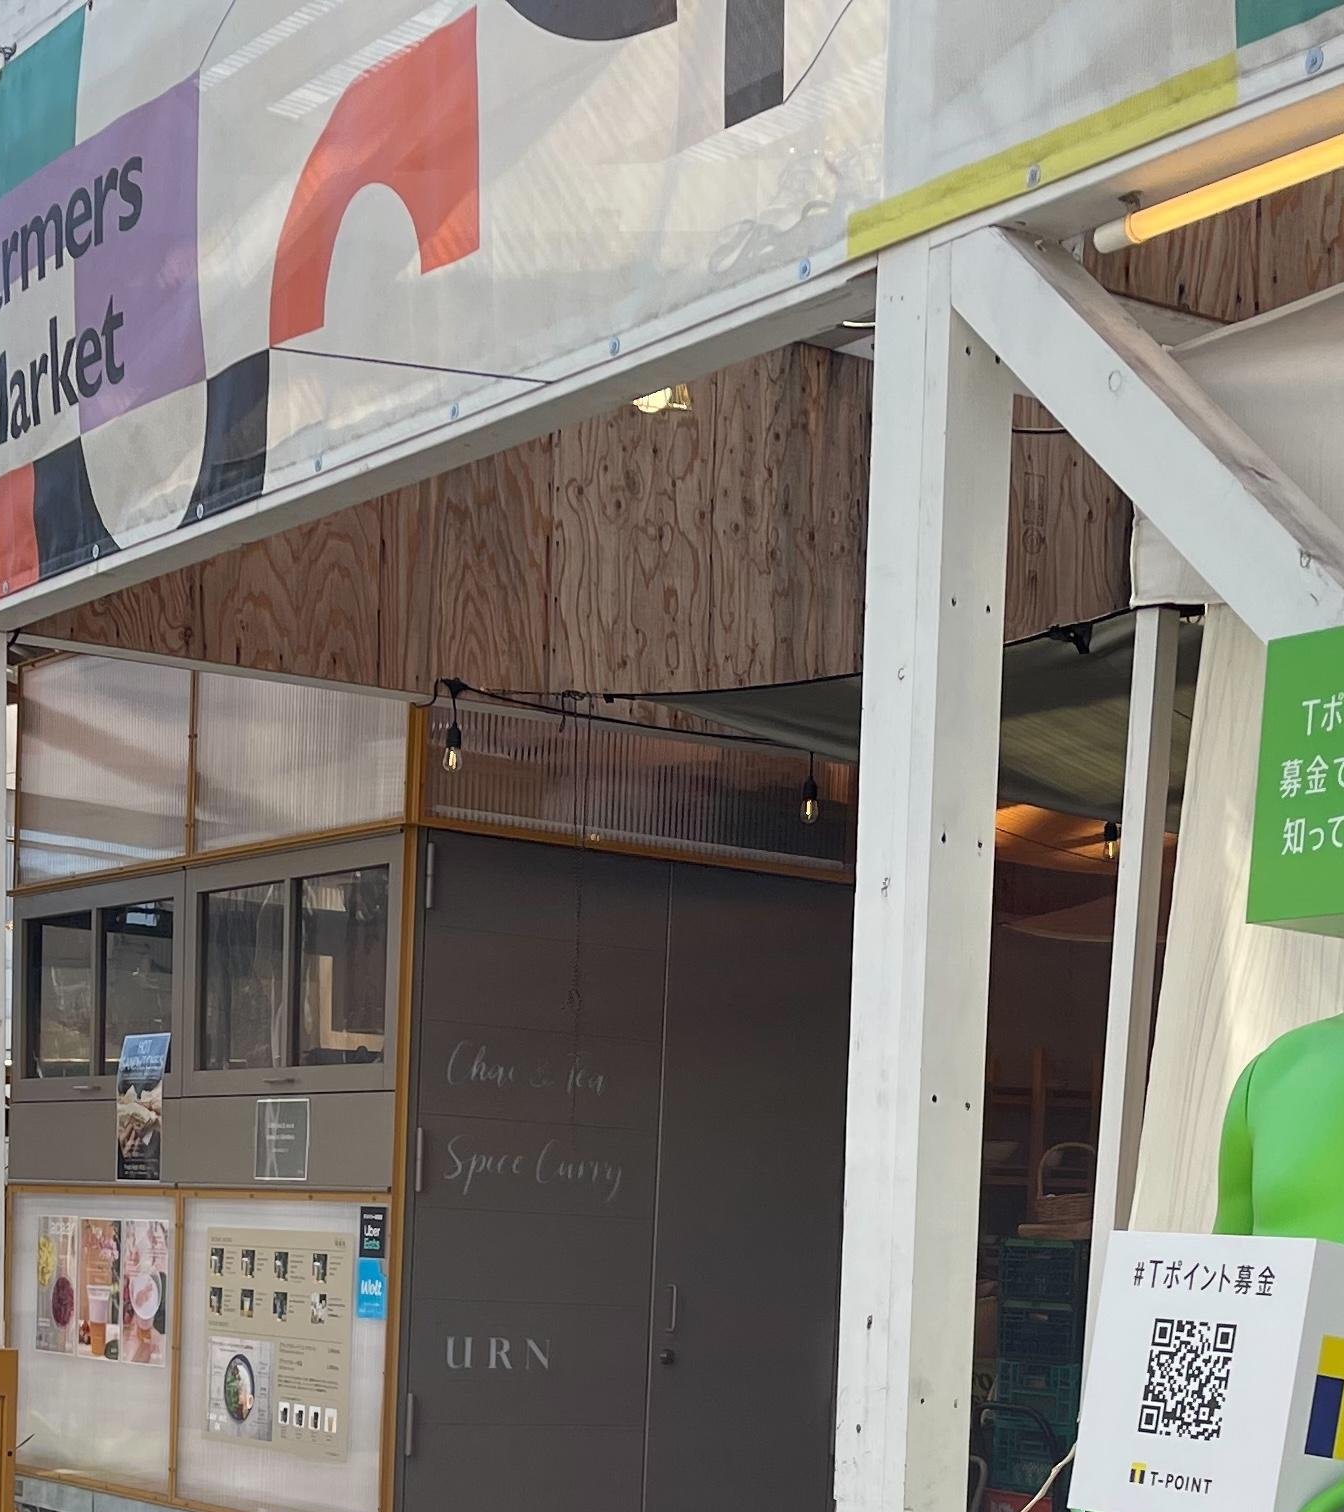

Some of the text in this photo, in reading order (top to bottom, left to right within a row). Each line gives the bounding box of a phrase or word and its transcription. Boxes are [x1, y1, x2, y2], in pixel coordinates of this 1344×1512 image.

[445, 1136, 622, 1202] Spice Curry
[364, 1225, 381, 1237] Uber
[360, 1280, 383, 1296] Wolt
[1133, 1259, 1276, 1297] #Tポイント募金
[446, 1336, 551, 1369] URN
[1150, 1471, 1213, 1495] T-POINT
